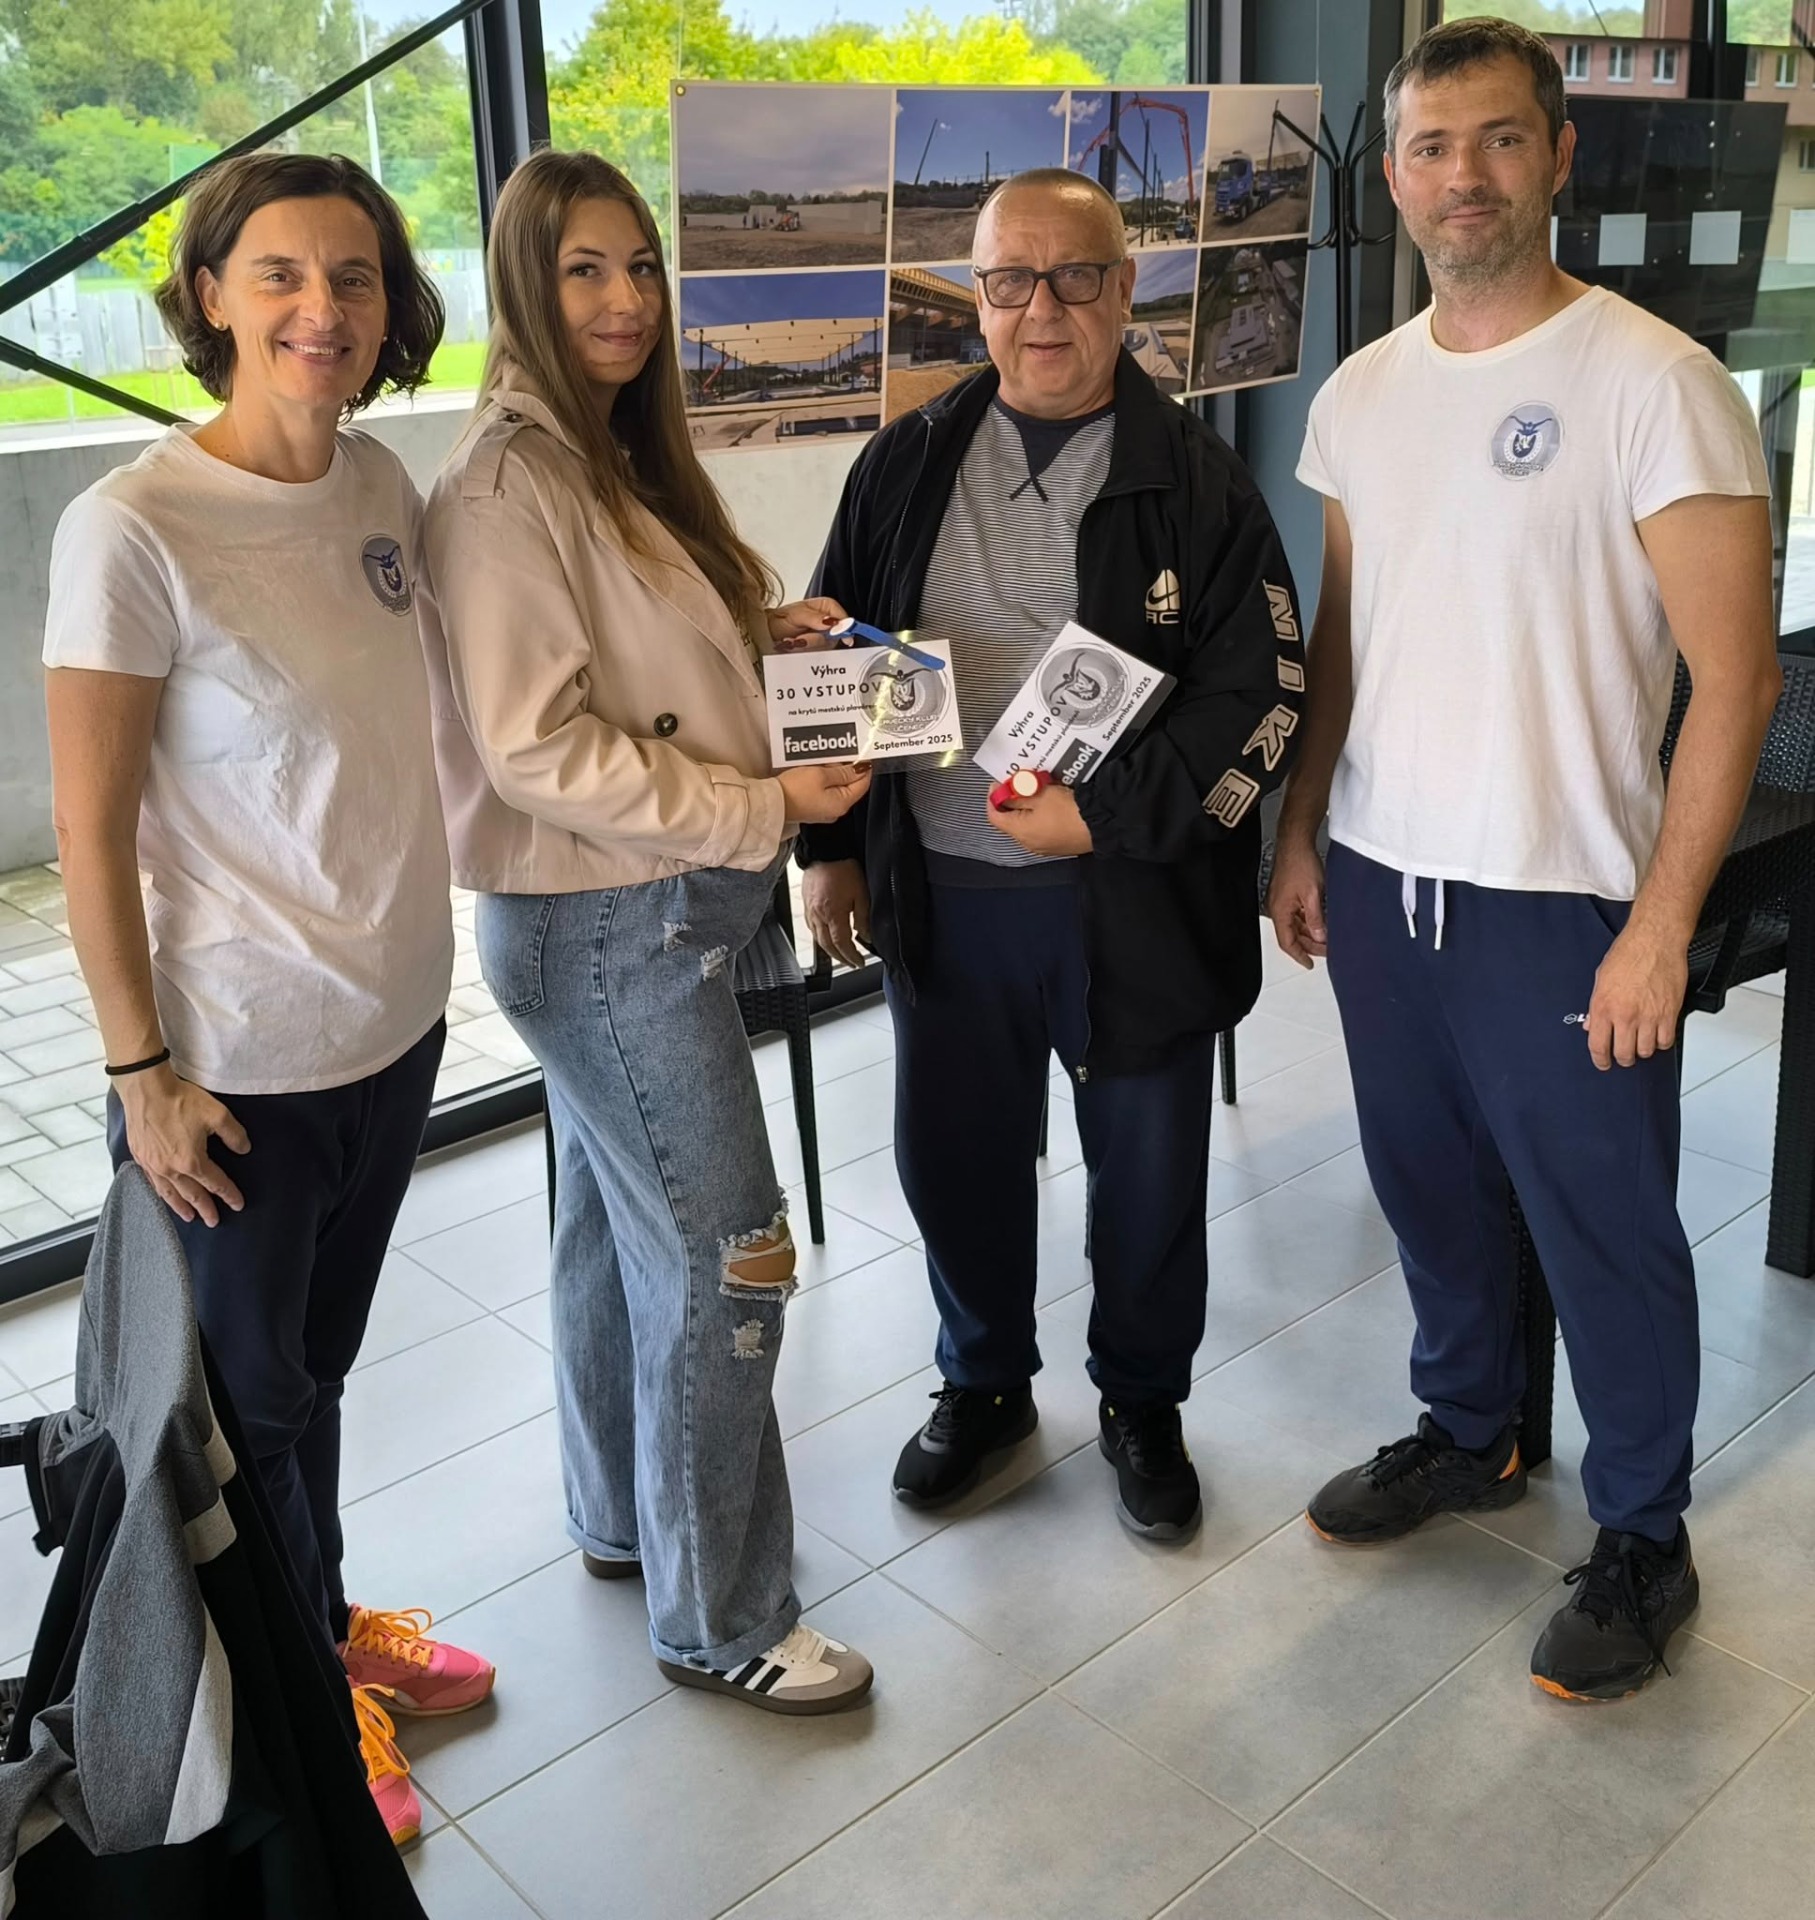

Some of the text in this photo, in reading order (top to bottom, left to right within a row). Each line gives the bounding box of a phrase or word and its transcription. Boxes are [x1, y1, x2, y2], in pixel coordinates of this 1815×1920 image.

[811, 664, 846, 679] Výhra
[777, 681, 880, 700] 30 VSTUPOV
[1202, 579, 1306, 828] NIKE
[1102, 700, 1135, 741] September
[1131, 676, 1152, 699] 2025
[1008, 711, 1034, 738] Výhra
[1018, 696, 1067, 758] VSTUPOV
[785, 732, 857, 753] facebook
[874, 734, 953, 751] September 2025
[1062, 745, 1095, 785] ebook
